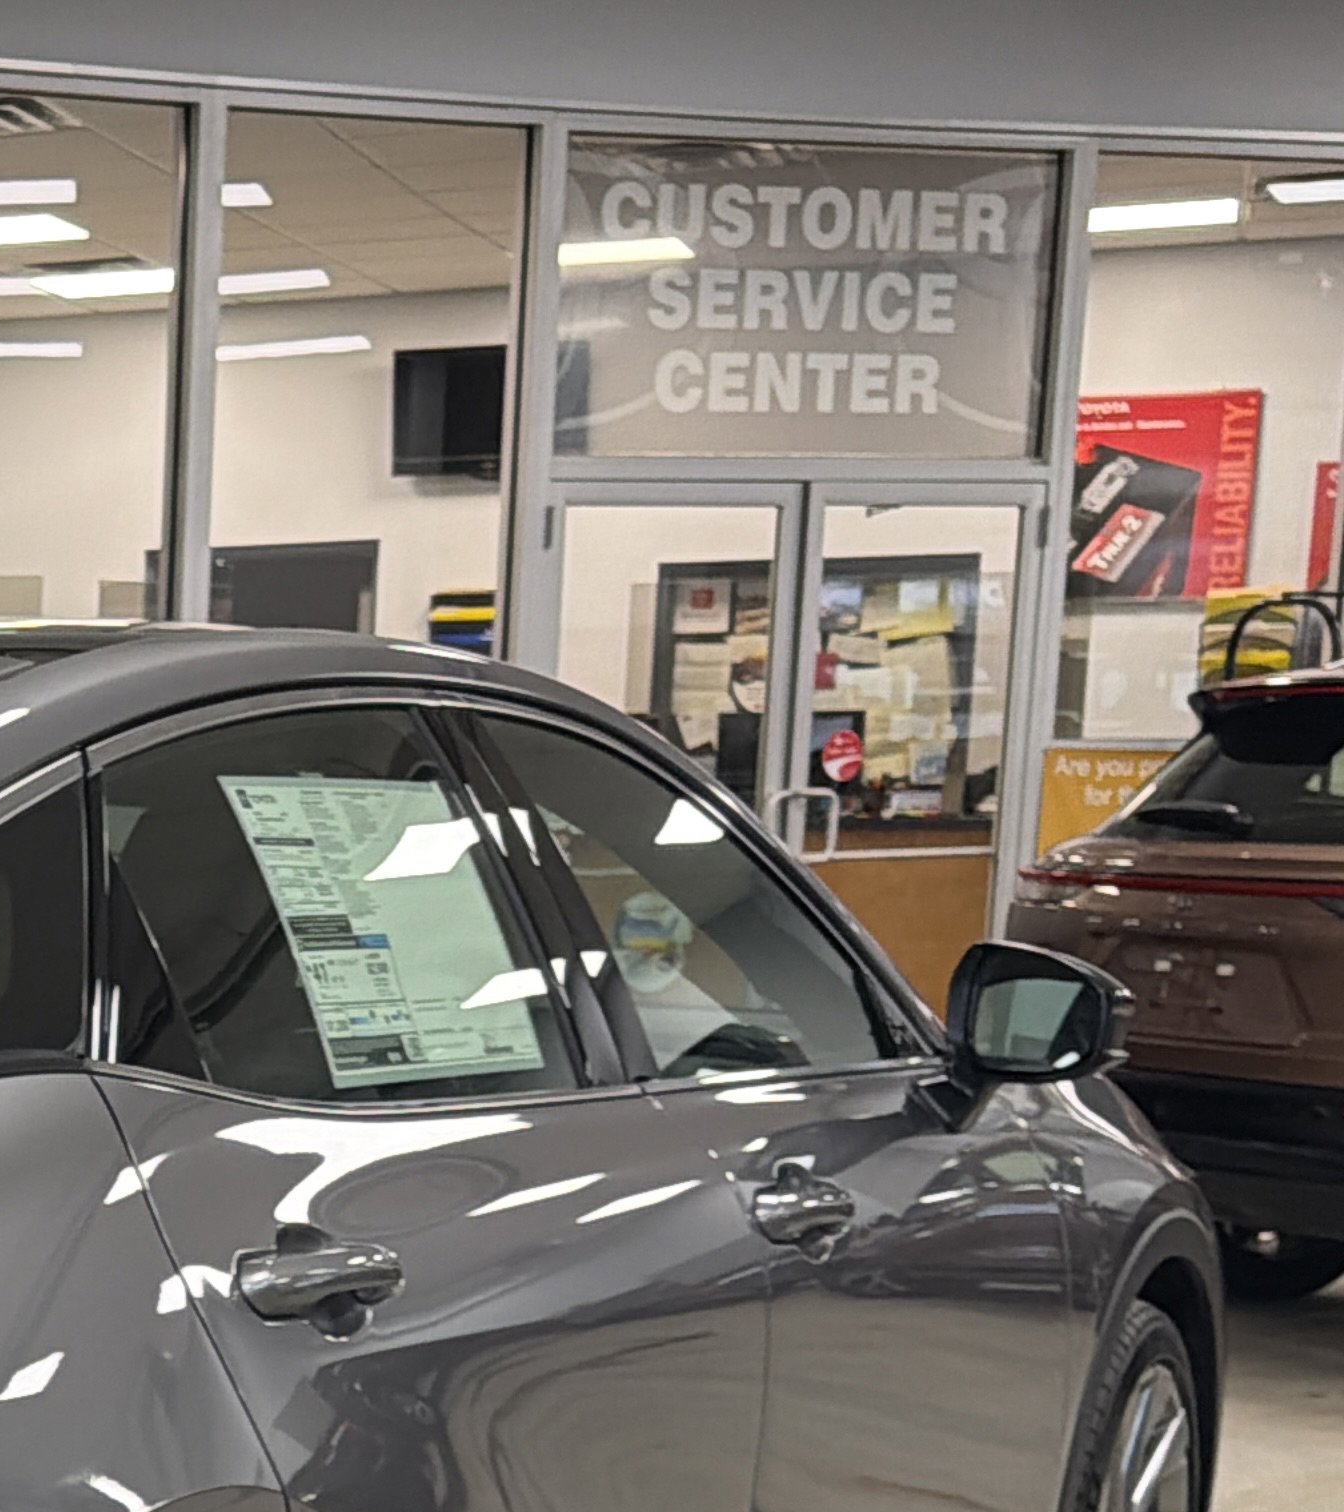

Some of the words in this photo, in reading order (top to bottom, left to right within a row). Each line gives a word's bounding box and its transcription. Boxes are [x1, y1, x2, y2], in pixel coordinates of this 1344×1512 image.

[600, 181, 1009, 255] CUSTOMER
[646, 266, 958, 335] SERVICE
[654, 348, 942, 415] CENTER
[1208, 397, 1257, 589] RELIABILITY.
[1054, 754, 1092, 778] Are
[1096, 758, 1135, 782] you
[1084, 784, 1113, 807] for
